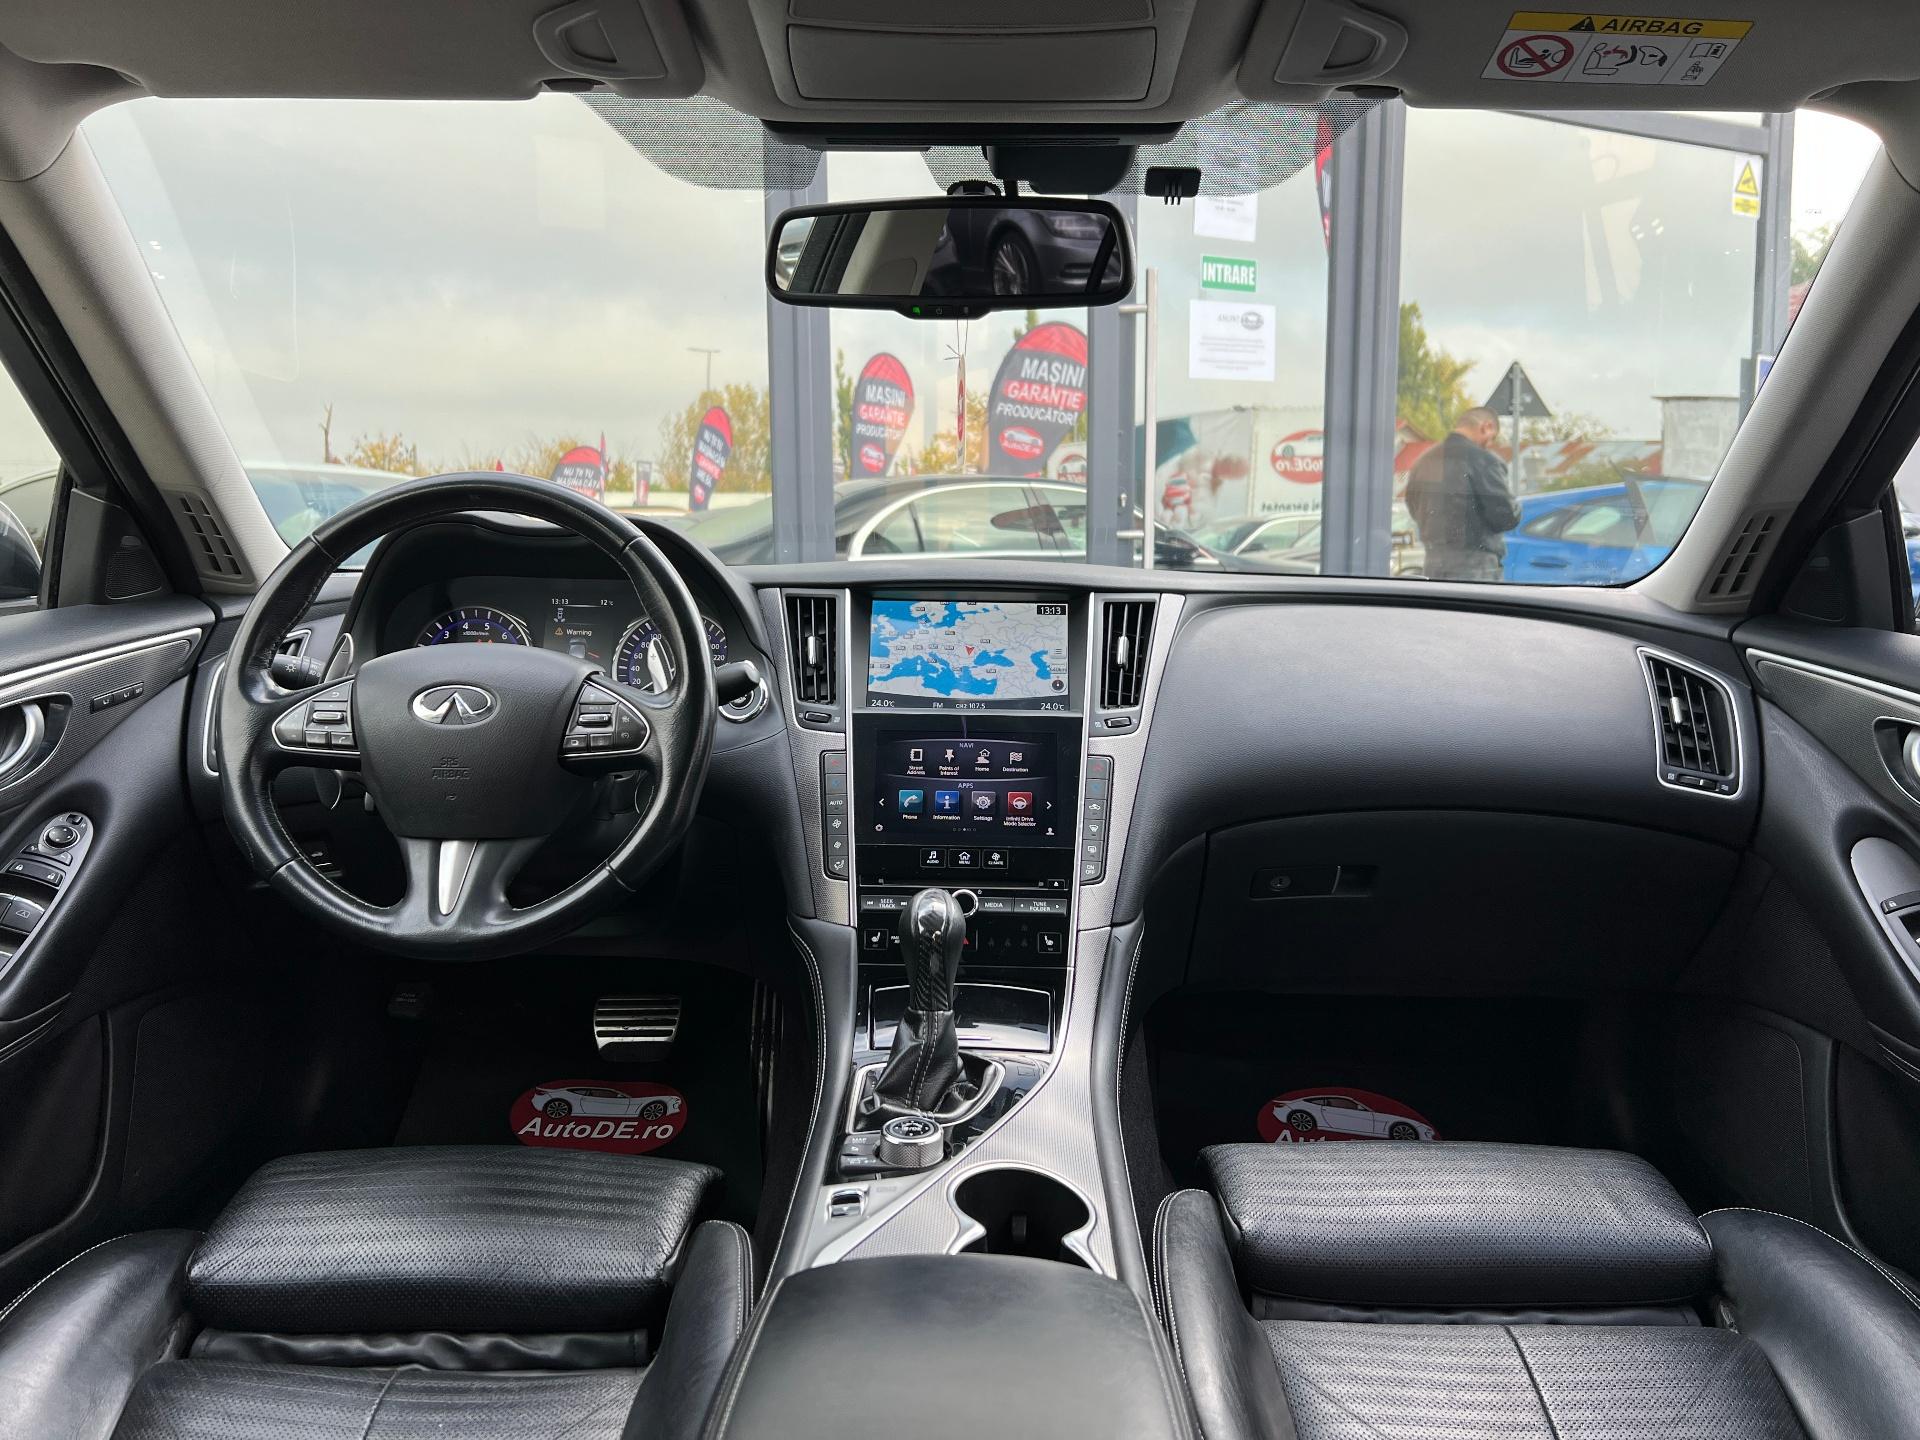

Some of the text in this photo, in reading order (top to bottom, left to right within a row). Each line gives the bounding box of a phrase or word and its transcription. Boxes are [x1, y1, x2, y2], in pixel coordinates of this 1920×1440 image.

[1599, 19, 1704, 35] AIRBAG
[1203, 262, 1255, 286] INTRARE
[1007, 381, 1082, 409] GARANȚIE
[551, 598, 569, 606] 13:13
[1039, 606, 1062, 615] 13:13
[462, 622, 469, 630] 4
[484, 622, 490, 631] 5
[443, 630, 450, 639] 3
[501, 632, 508, 640] 6
[566, 628, 592, 637] Warning
[640, 641, 650, 649] 80
[633, 652, 643, 660] 60
[432, 769, 471, 780] AIRBAG
[518, 1117, 674, 1139] AutoDE.ro
